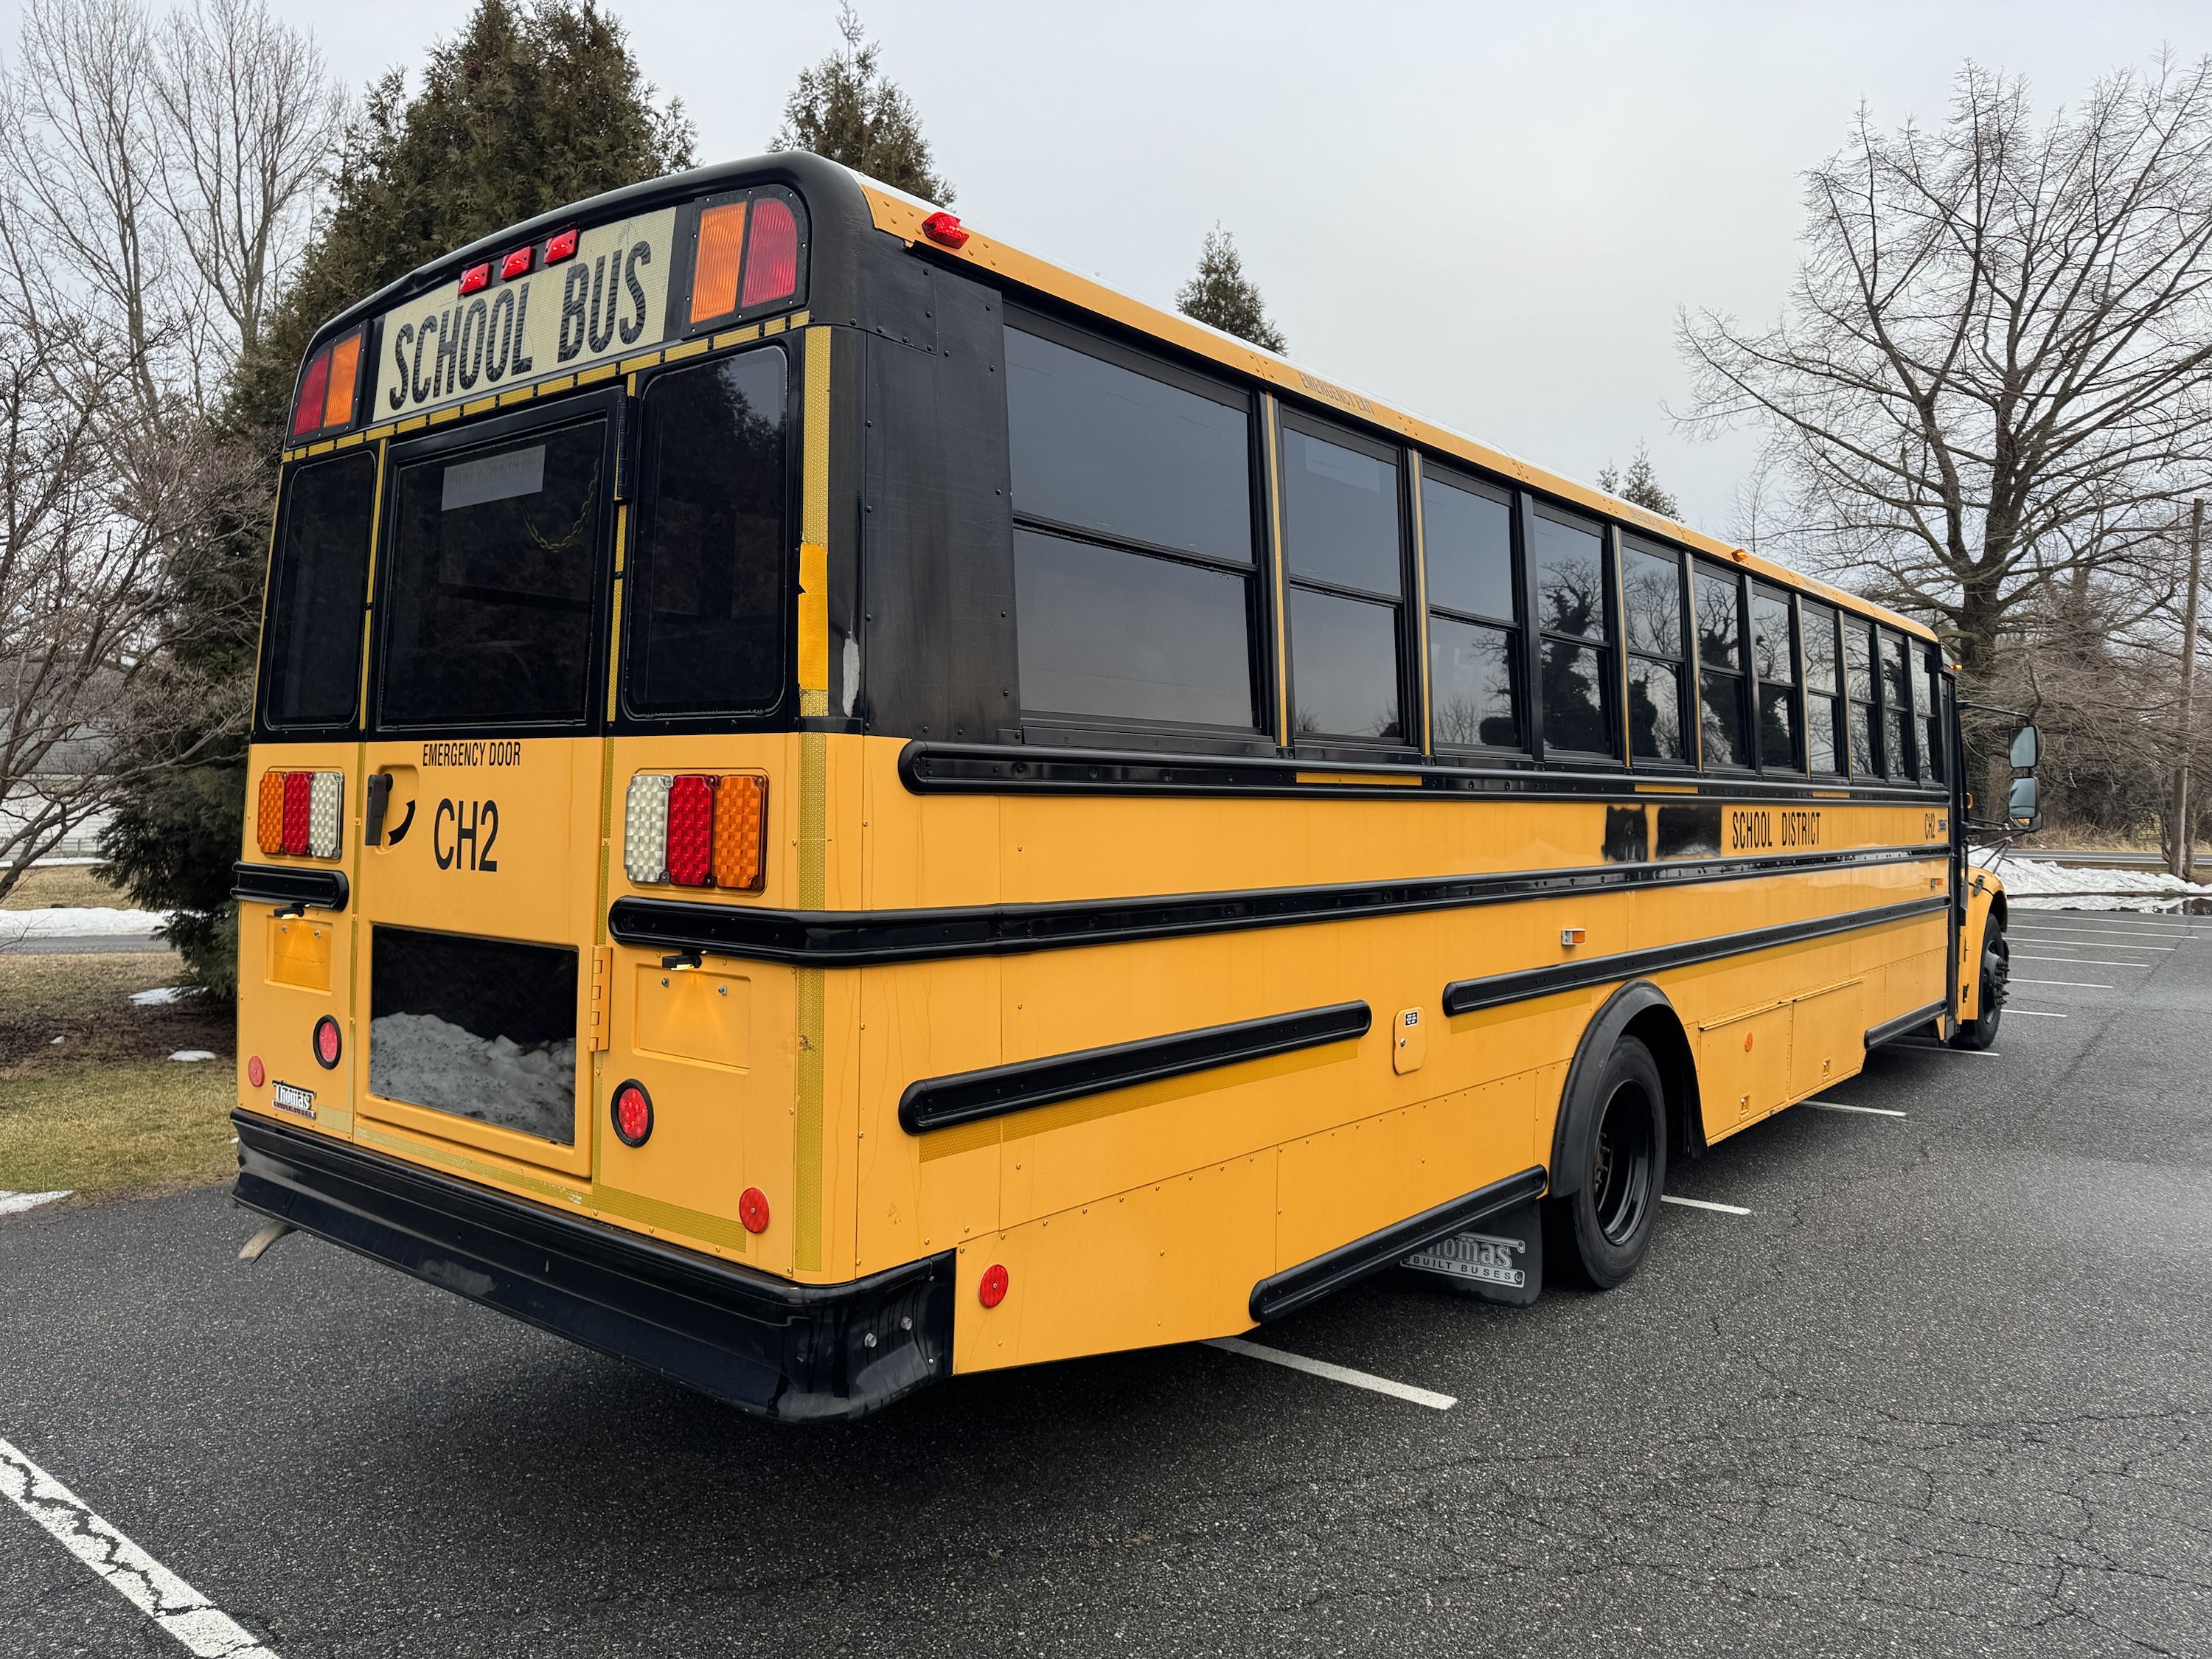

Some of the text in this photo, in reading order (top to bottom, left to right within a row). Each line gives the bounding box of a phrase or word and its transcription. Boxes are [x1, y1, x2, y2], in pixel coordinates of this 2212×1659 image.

[389, 241, 651, 410] SCHOOL BUS
[1298, 372, 1375, 416] EMERGENCY EXIT
[422, 742, 521, 767] EMERGENCY DOOR
[434, 798, 499, 872] CH2
[1733, 811, 1820, 849] SCHOOL DISTRICT
[1924, 813, 1935, 840] CH2
[272, 1082, 315, 1110] Thomas
[1413, 1256, 1512, 1280] BUILT BUSES
